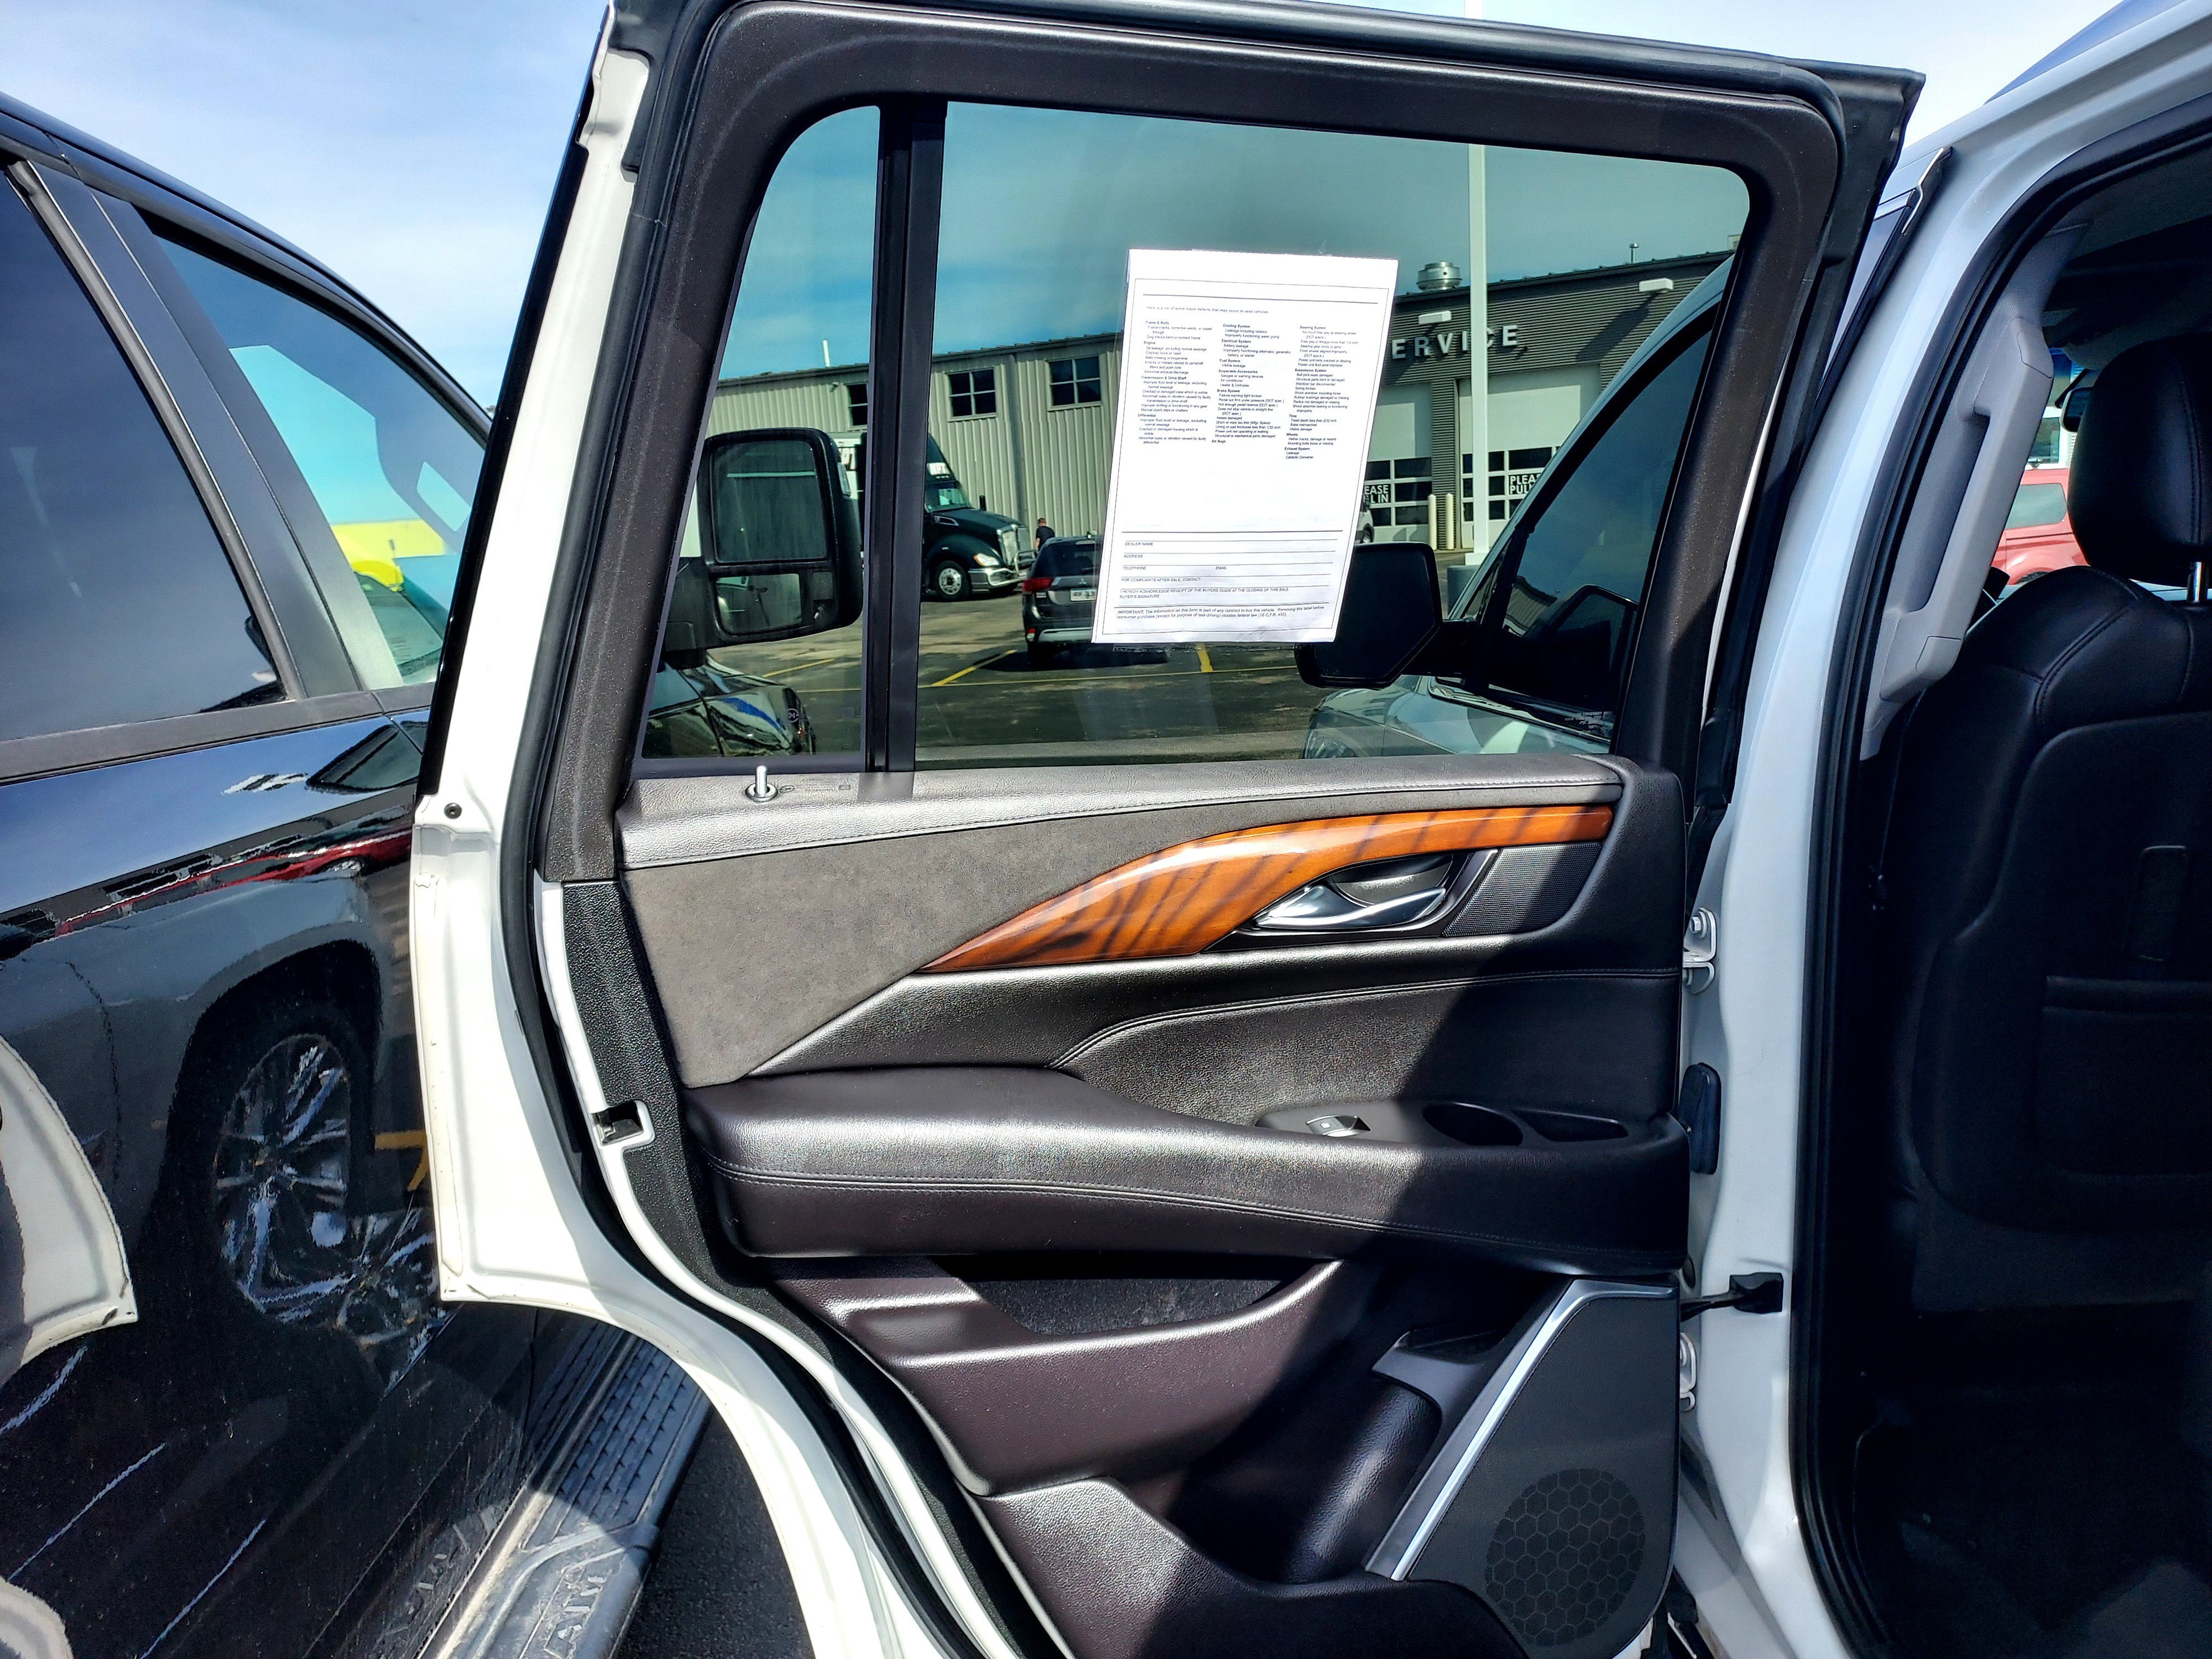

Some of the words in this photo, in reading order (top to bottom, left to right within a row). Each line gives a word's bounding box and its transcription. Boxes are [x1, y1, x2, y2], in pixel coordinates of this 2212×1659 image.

[1392, 325, 1518, 359] ERVIE
[1510, 474, 1541, 486] PLEA
[1364, 484, 1389, 495] EASE
[1378, 494, 1389, 503] IN
